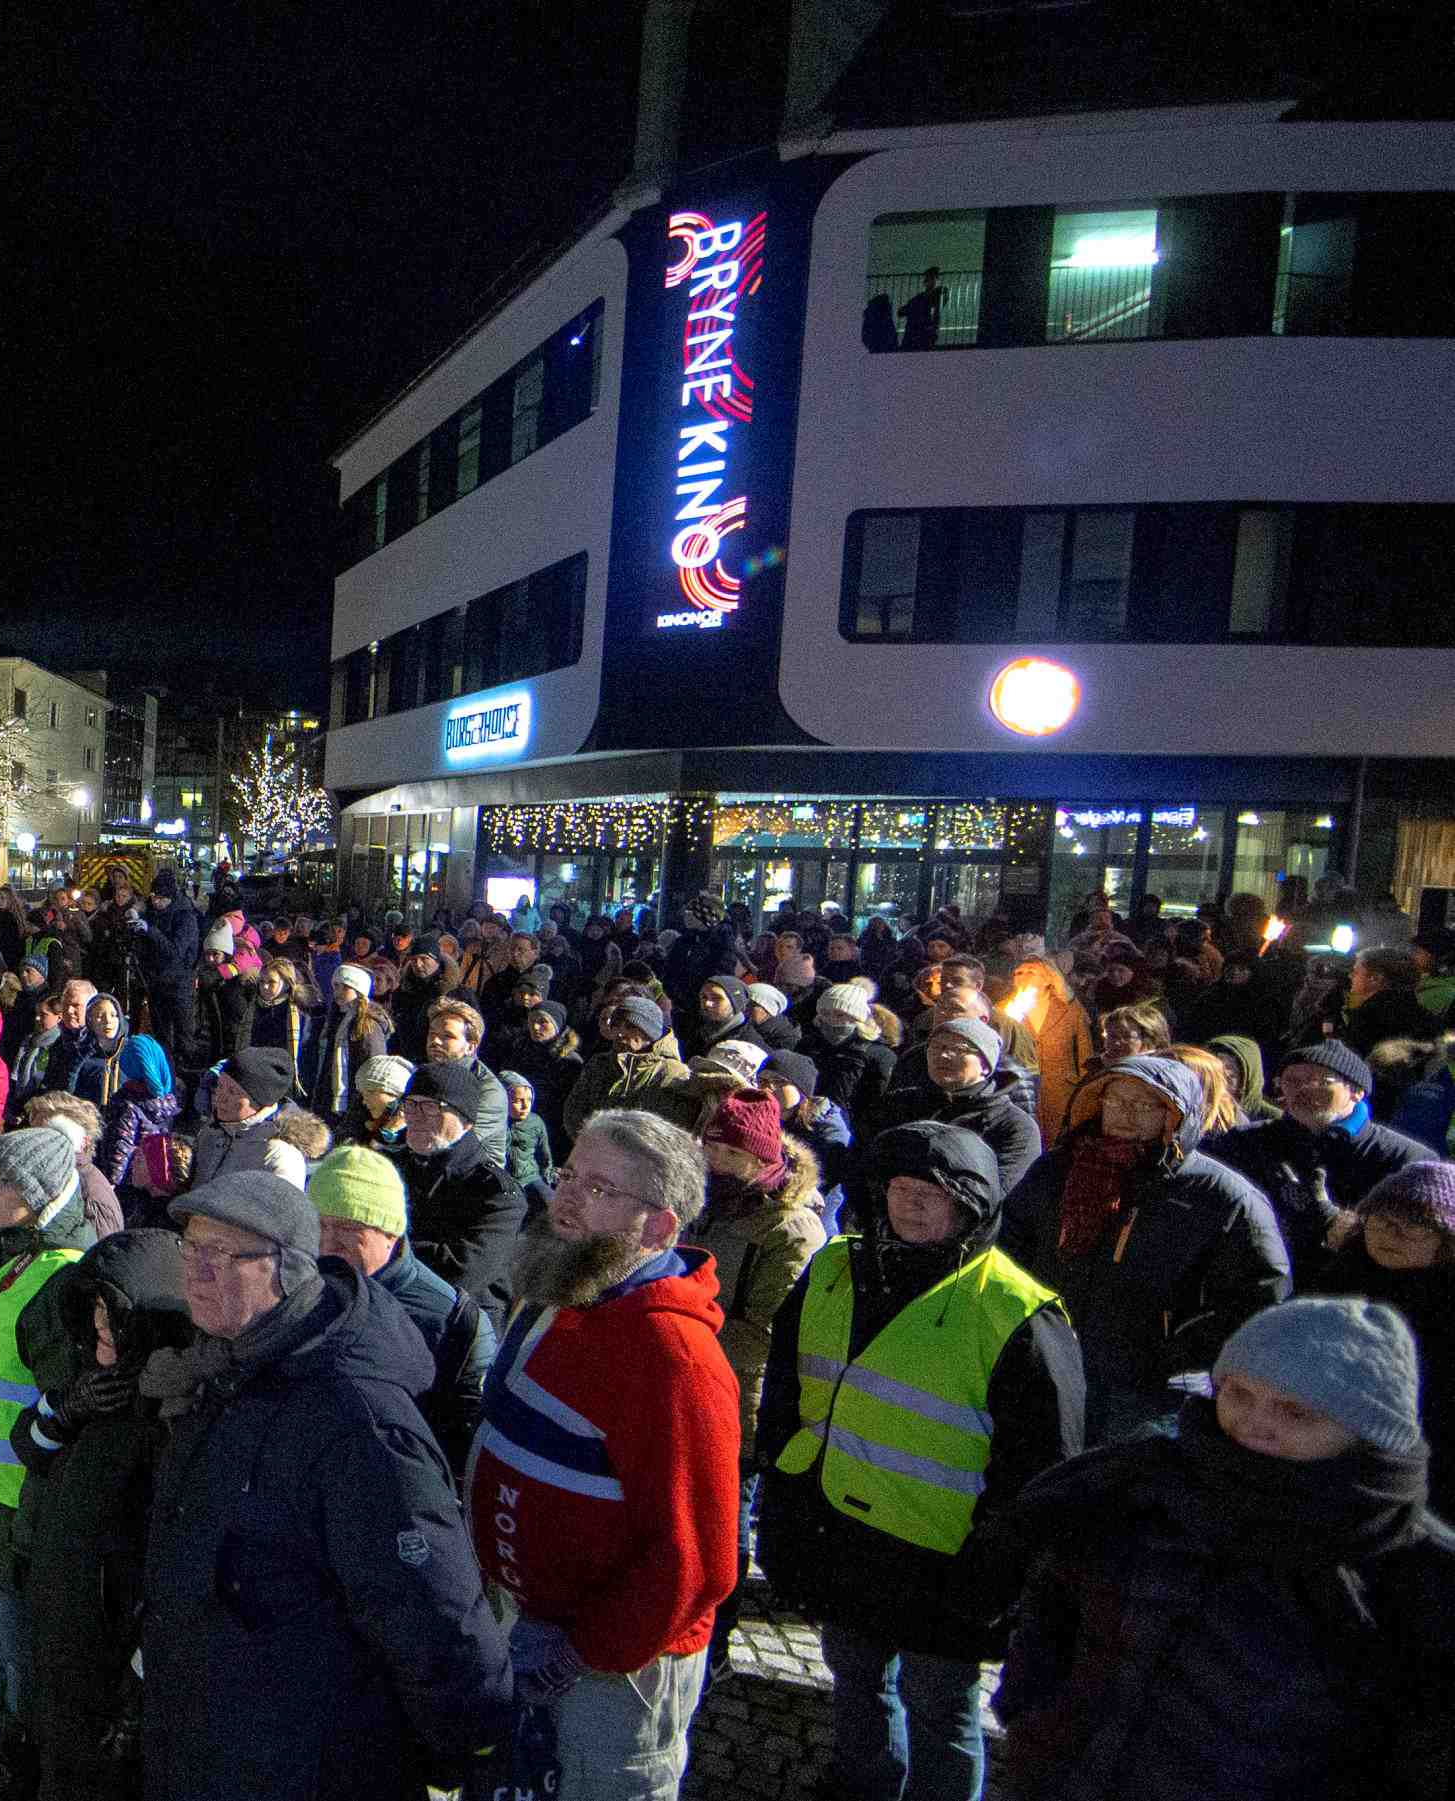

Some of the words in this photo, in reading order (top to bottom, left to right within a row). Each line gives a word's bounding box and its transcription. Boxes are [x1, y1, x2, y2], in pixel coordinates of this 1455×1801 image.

[680, 220, 742, 408] BRYNE
[671, 419, 729, 569] KINO
[494, 1481, 528, 1602] NORG
